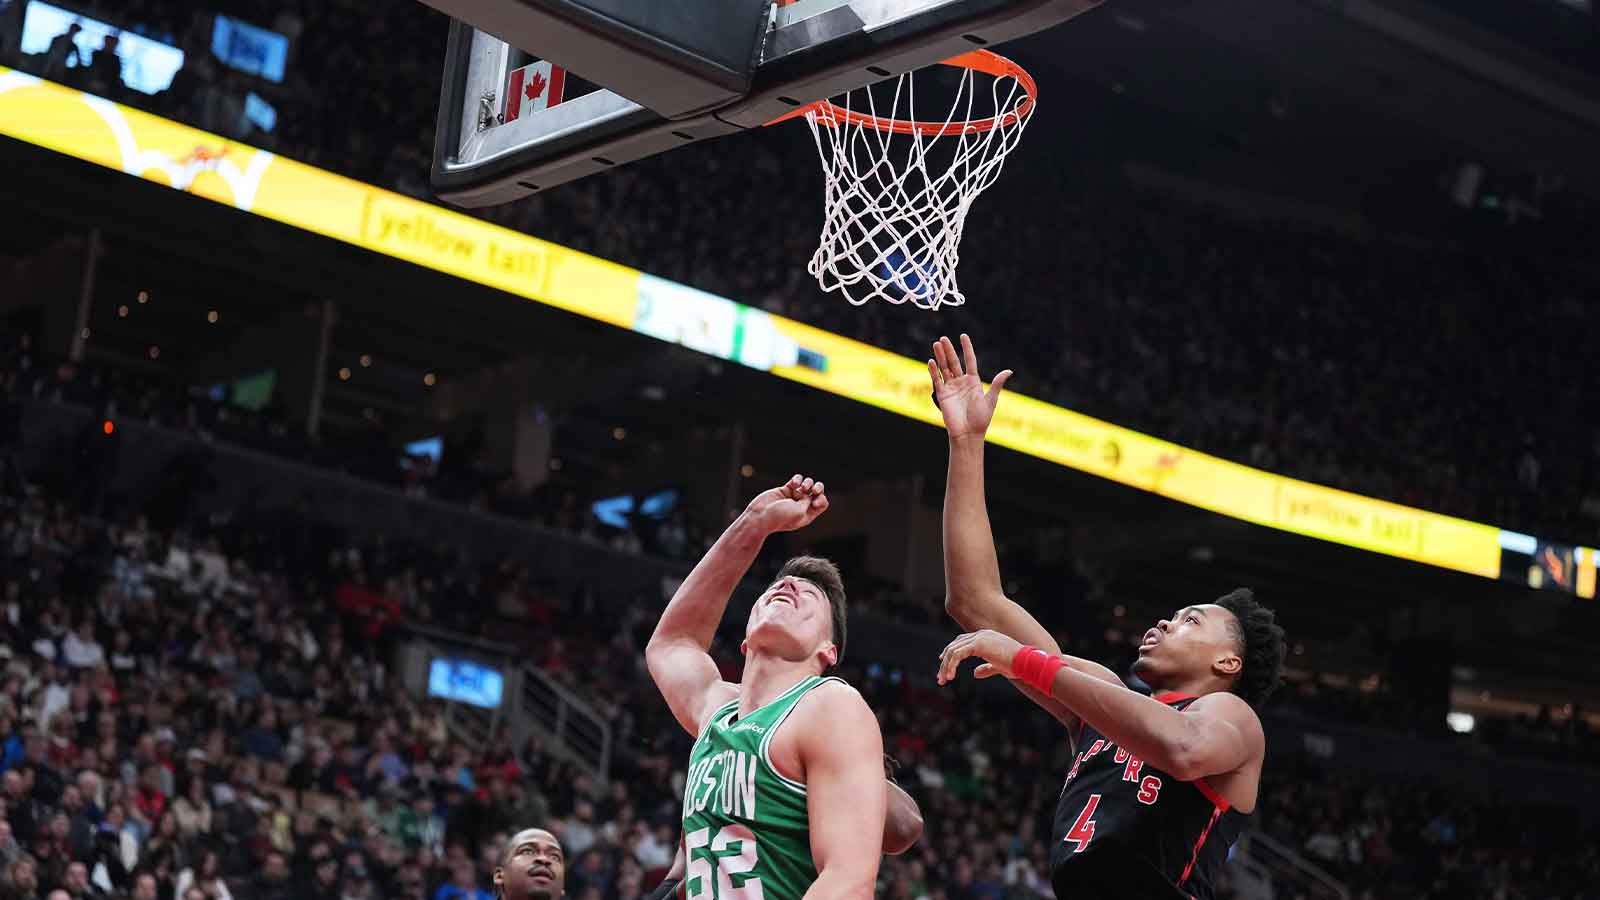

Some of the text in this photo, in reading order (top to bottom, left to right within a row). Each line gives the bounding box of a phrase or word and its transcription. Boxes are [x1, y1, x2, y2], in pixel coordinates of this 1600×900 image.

[1060, 740, 1162, 805] APORS
[1064, 794, 1101, 853] 4
[686, 824, 765, 900] 52
